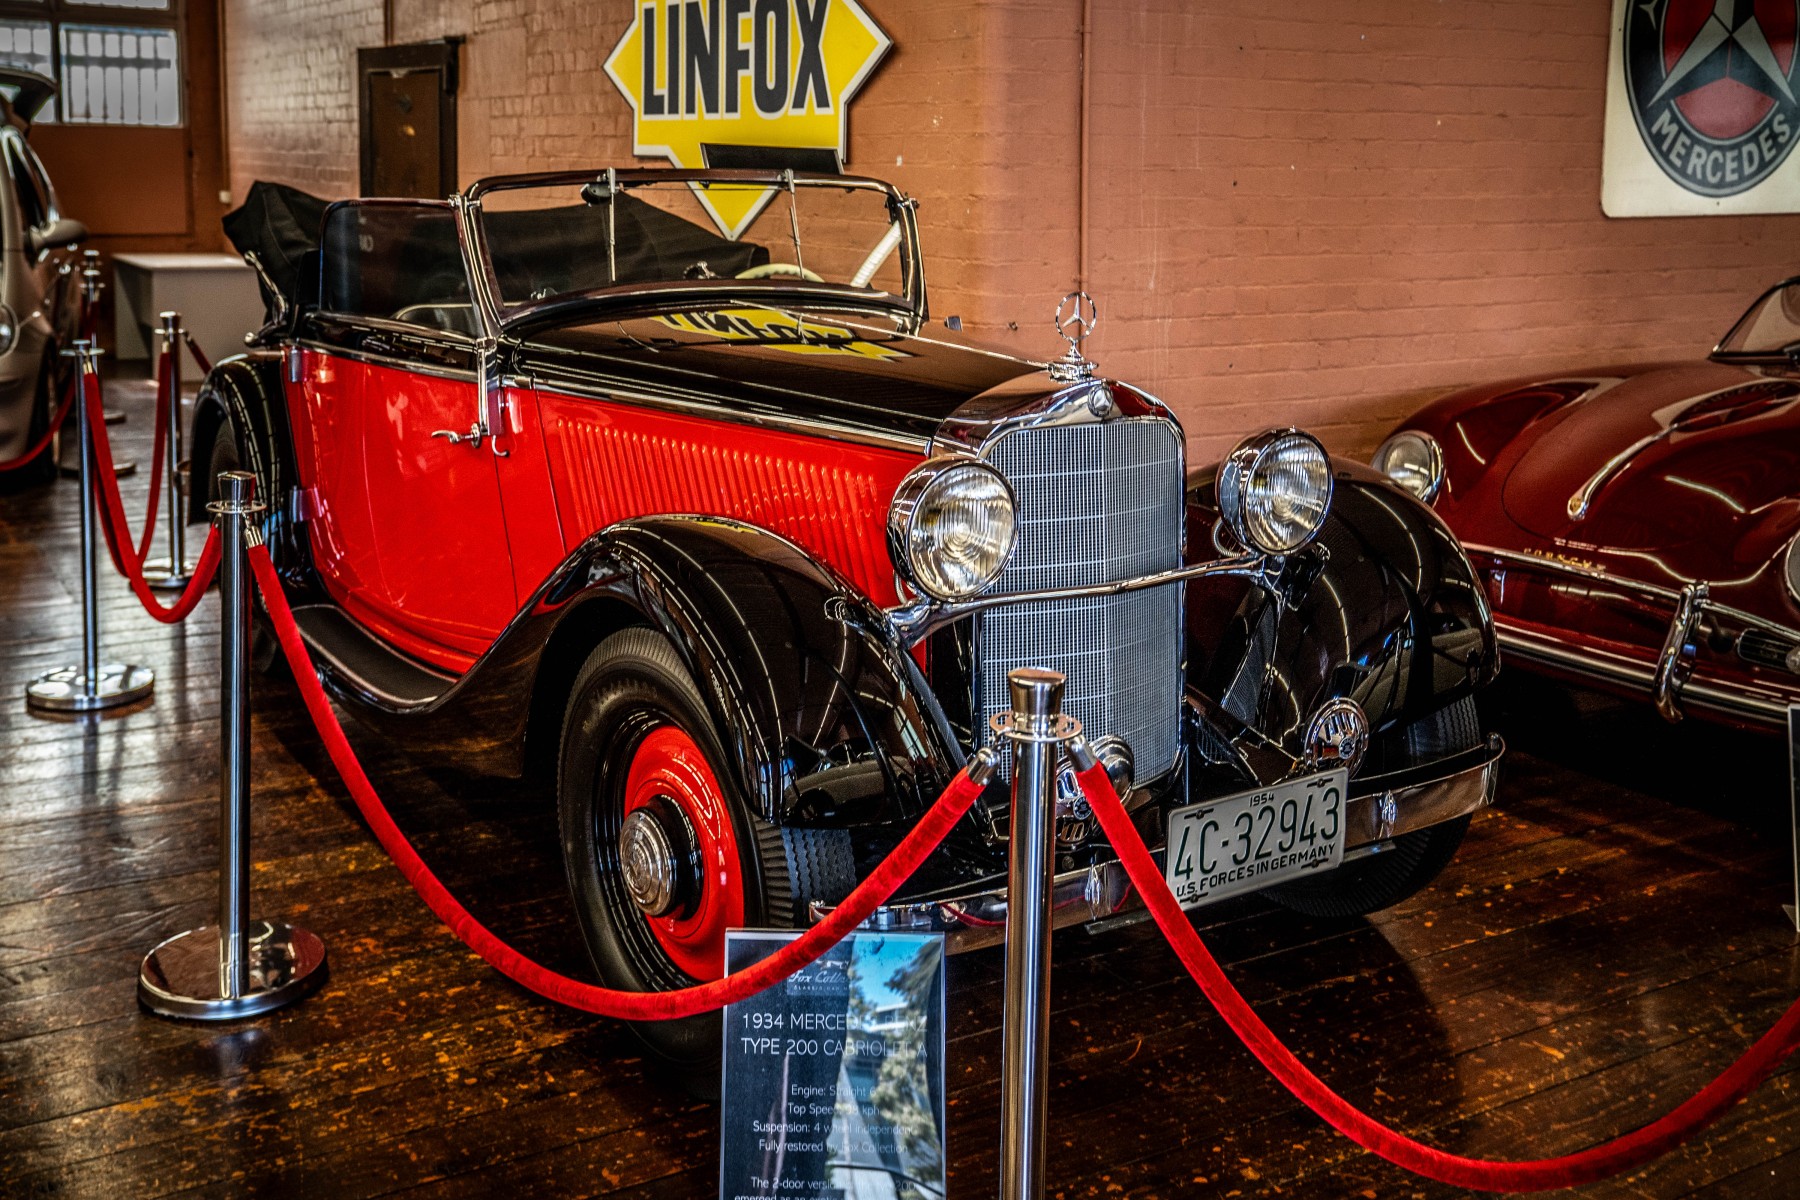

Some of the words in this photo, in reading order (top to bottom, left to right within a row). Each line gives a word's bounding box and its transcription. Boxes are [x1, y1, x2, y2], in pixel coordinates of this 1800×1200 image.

[642, 0, 832, 117] LINFOX
[1650, 108, 1791, 184] MERCEDES
[1250, 791, 1275, 807] 1954
[1174, 786, 1341, 880] 4C-32943
[1176, 881, 1198, 897] U.S.
[1271, 842, 1336, 870] GERMANY
[788, 969, 812, 983] Fox
[743, 1013, 784, 1030] 1934
[740, 1037, 780, 1055] TYPE
[786, 1039, 818, 1056] 200
[823, 1040, 911, 1057] CABRIOLET
[916, 1041, 928, 1058] A
[791, 1084, 826, 1099] Engine:
[829, 1085, 867, 1099] Straight
[788, 1102, 806, 1116] Top
[809, 1103, 842, 1117] Spee
[862, 1103, 880, 1118] kph
[752, 1120, 811, 1134] Suspension:
[813, 1122, 820, 1133] 4
[823, 1123, 852, 1134] whel
[759, 1139, 781, 1153] Fully
[783, 1140, 824, 1152] restored
[751, 1175, 770, 1189] The
[772, 1176, 804, 1190] 2-door
[807, 1178, 841, 1191] versio
